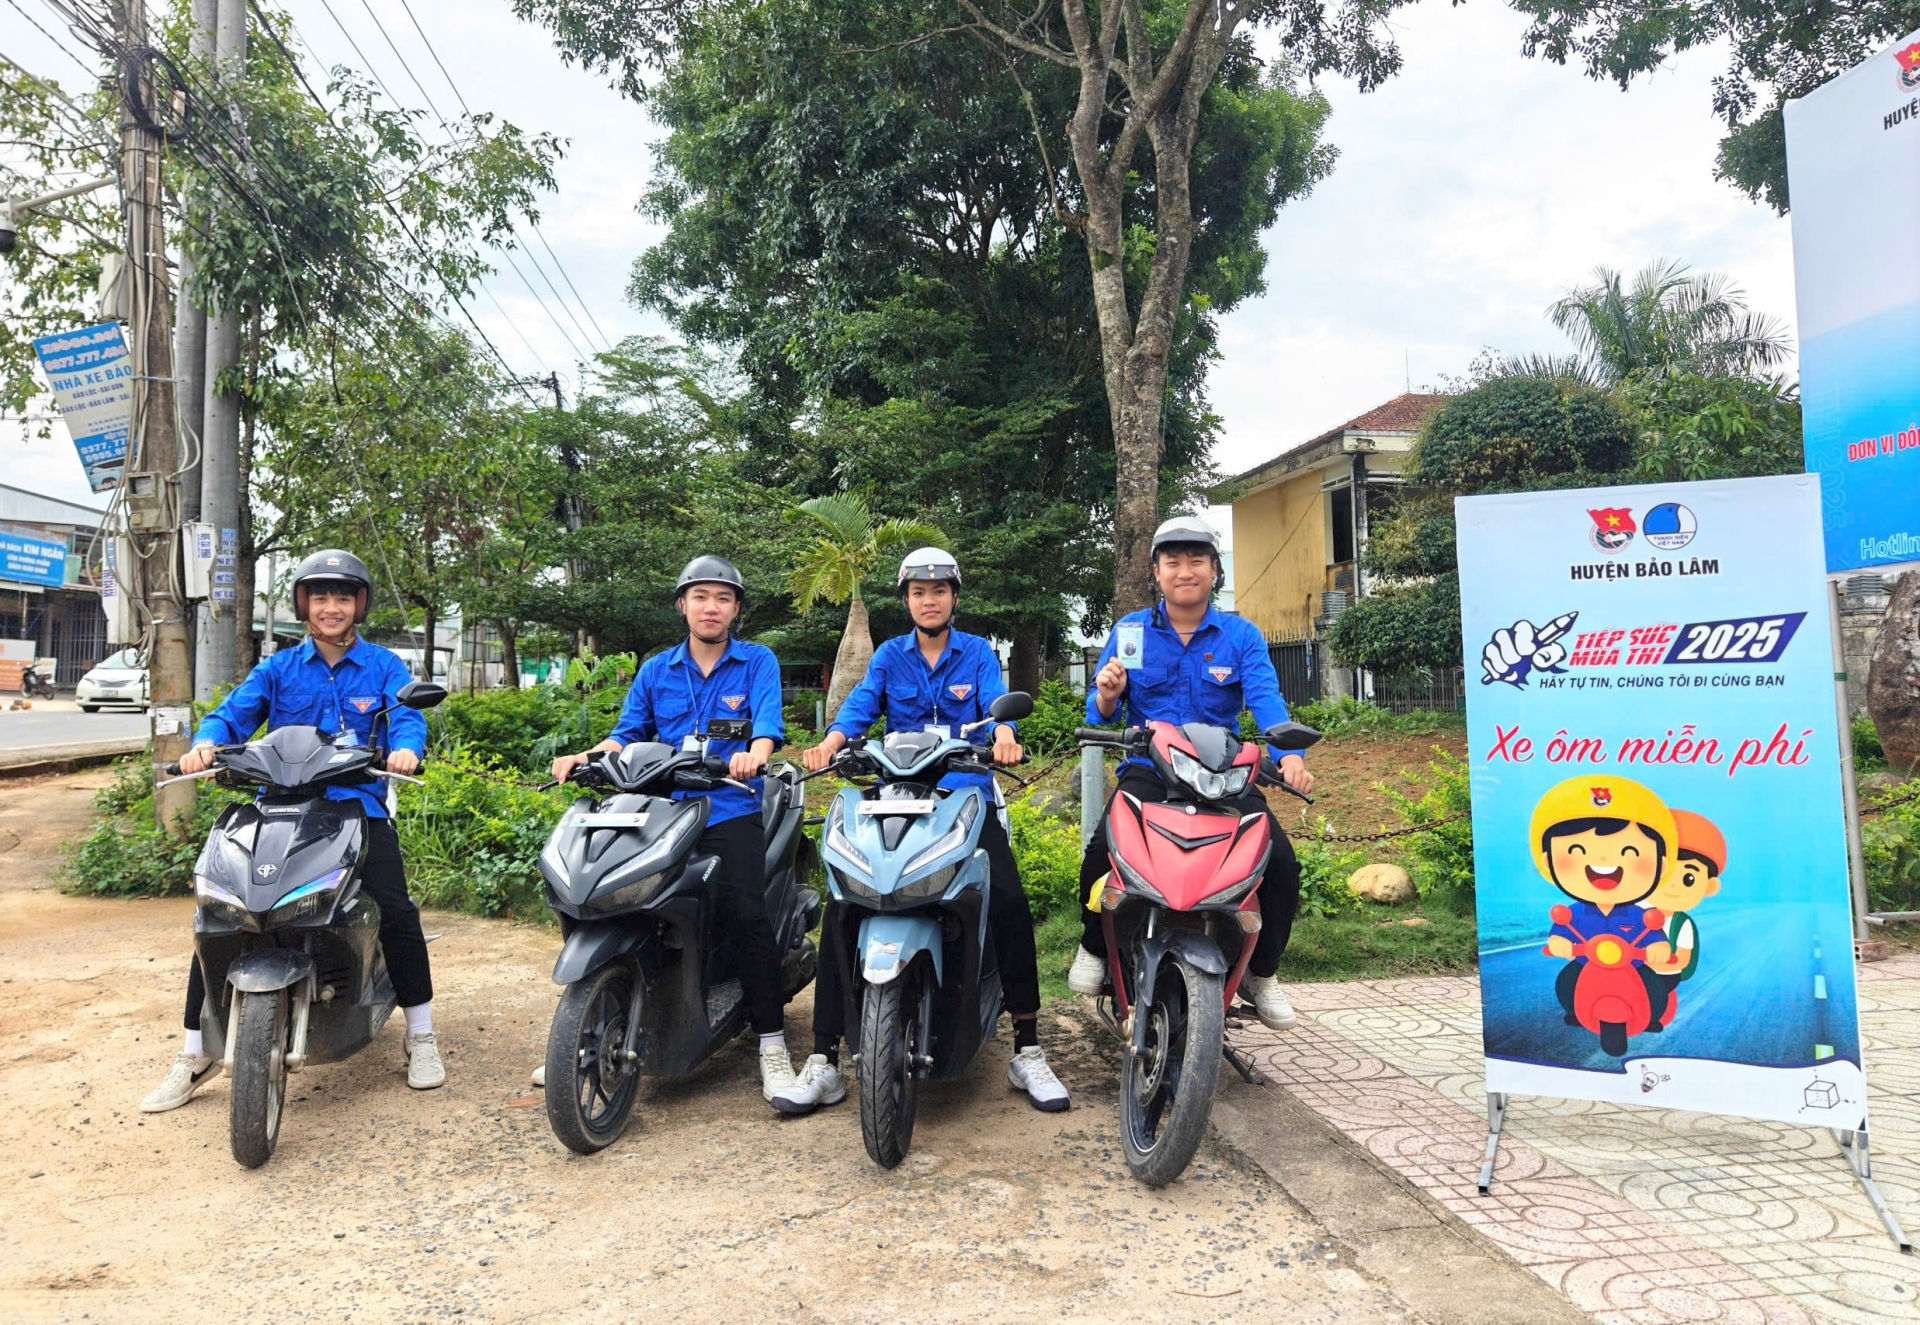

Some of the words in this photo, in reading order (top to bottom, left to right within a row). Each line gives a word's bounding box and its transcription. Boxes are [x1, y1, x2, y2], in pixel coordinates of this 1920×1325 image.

[1883, 97, 1920, 130] HUYỆ
[53, 374, 82, 391] NHÀ
[85, 371, 103, 386] XE
[1848, 438, 1877, 462] ĐƠN
[1880, 434, 1894, 457] VỊ
[1897, 422, 1920, 451] ĐỒ
[23, 543, 40, 556] KIM
[1860, 532, 1920, 560] Hotlin
[1570, 561, 1629, 582] HUYỆN
[1635, 557, 1672, 577] BẢO
[1679, 556, 1719, 576] LÂM
[1575, 629, 1625, 649] TIẾP
[1629, 623, 1678, 646] SỨC
[1677, 618, 1785, 660] 2025
[1625, 647, 1666, 665] THI
[1539, 676, 1566, 689] HÃY
[1570, 676, 1587, 690] TỰ
[1590, 677, 1613, 689] TIN,
[1617, 673, 1664, 688] CHÚNG
[1669, 673, 1690, 687] TÔI
[1694, 675, 1707, 687] ĐI
[1711, 673, 1750, 687] CÙNG
[1755, 675, 1785, 689] BẠN
[1486, 725, 1535, 763] Xe
[1545, 729, 1608, 764] ôm
[1617, 724, 1724, 765] miễn
[1727, 722, 1814, 777] phí
[702, 859, 718, 883] HONDA
